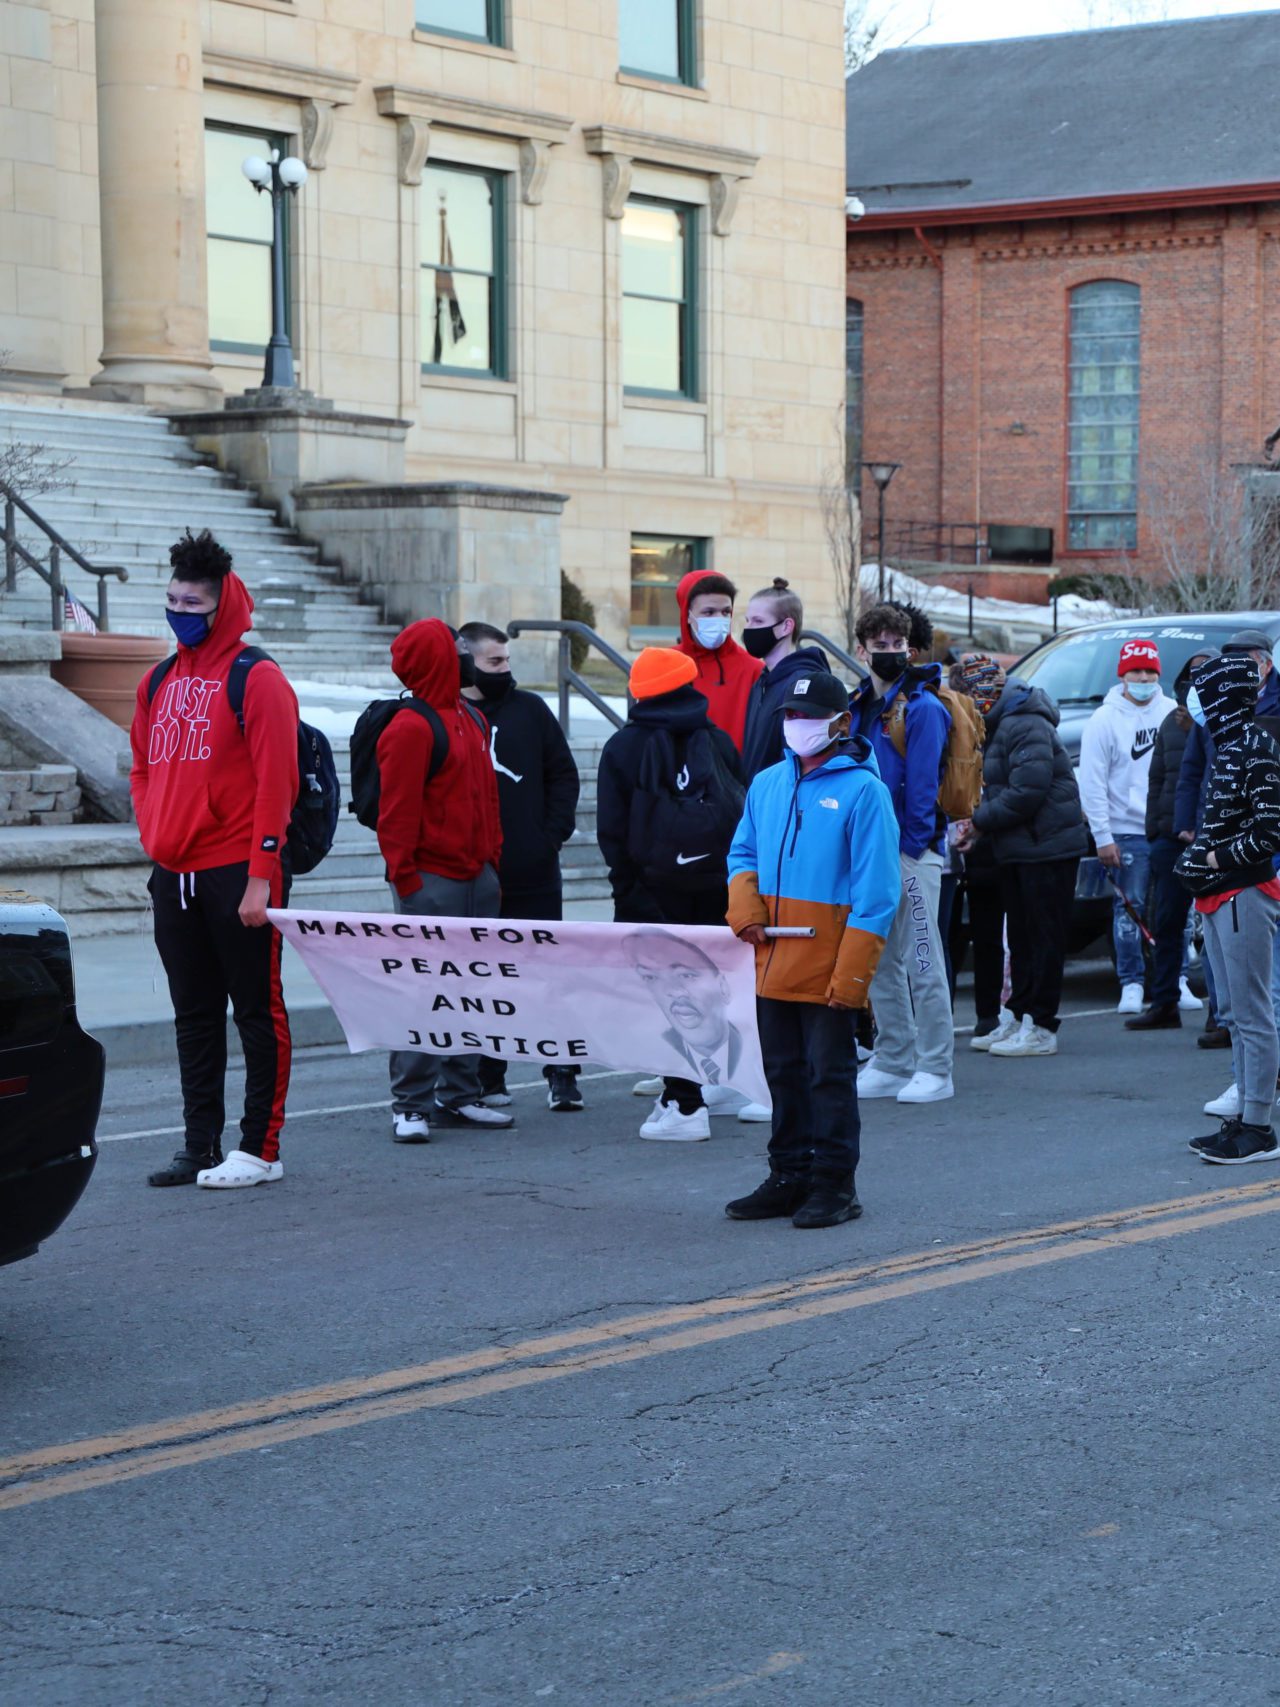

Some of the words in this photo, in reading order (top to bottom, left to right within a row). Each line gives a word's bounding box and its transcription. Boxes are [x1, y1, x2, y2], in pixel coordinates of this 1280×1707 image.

[1102, 629, 1154, 640] Show
[1158, 628, 1205, 640] Time
[157, 676, 222, 724] JUST
[148, 719, 181, 765] DO
[296, 919, 446, 941] MARCH
[470, 926, 559, 945] FOR
[905, 876, 931, 973] NAUTICA
[381, 957, 520, 978] PEACE
[432, 994, 517, 1016] AND
[408, 1029, 589, 1057] JUSTICE
